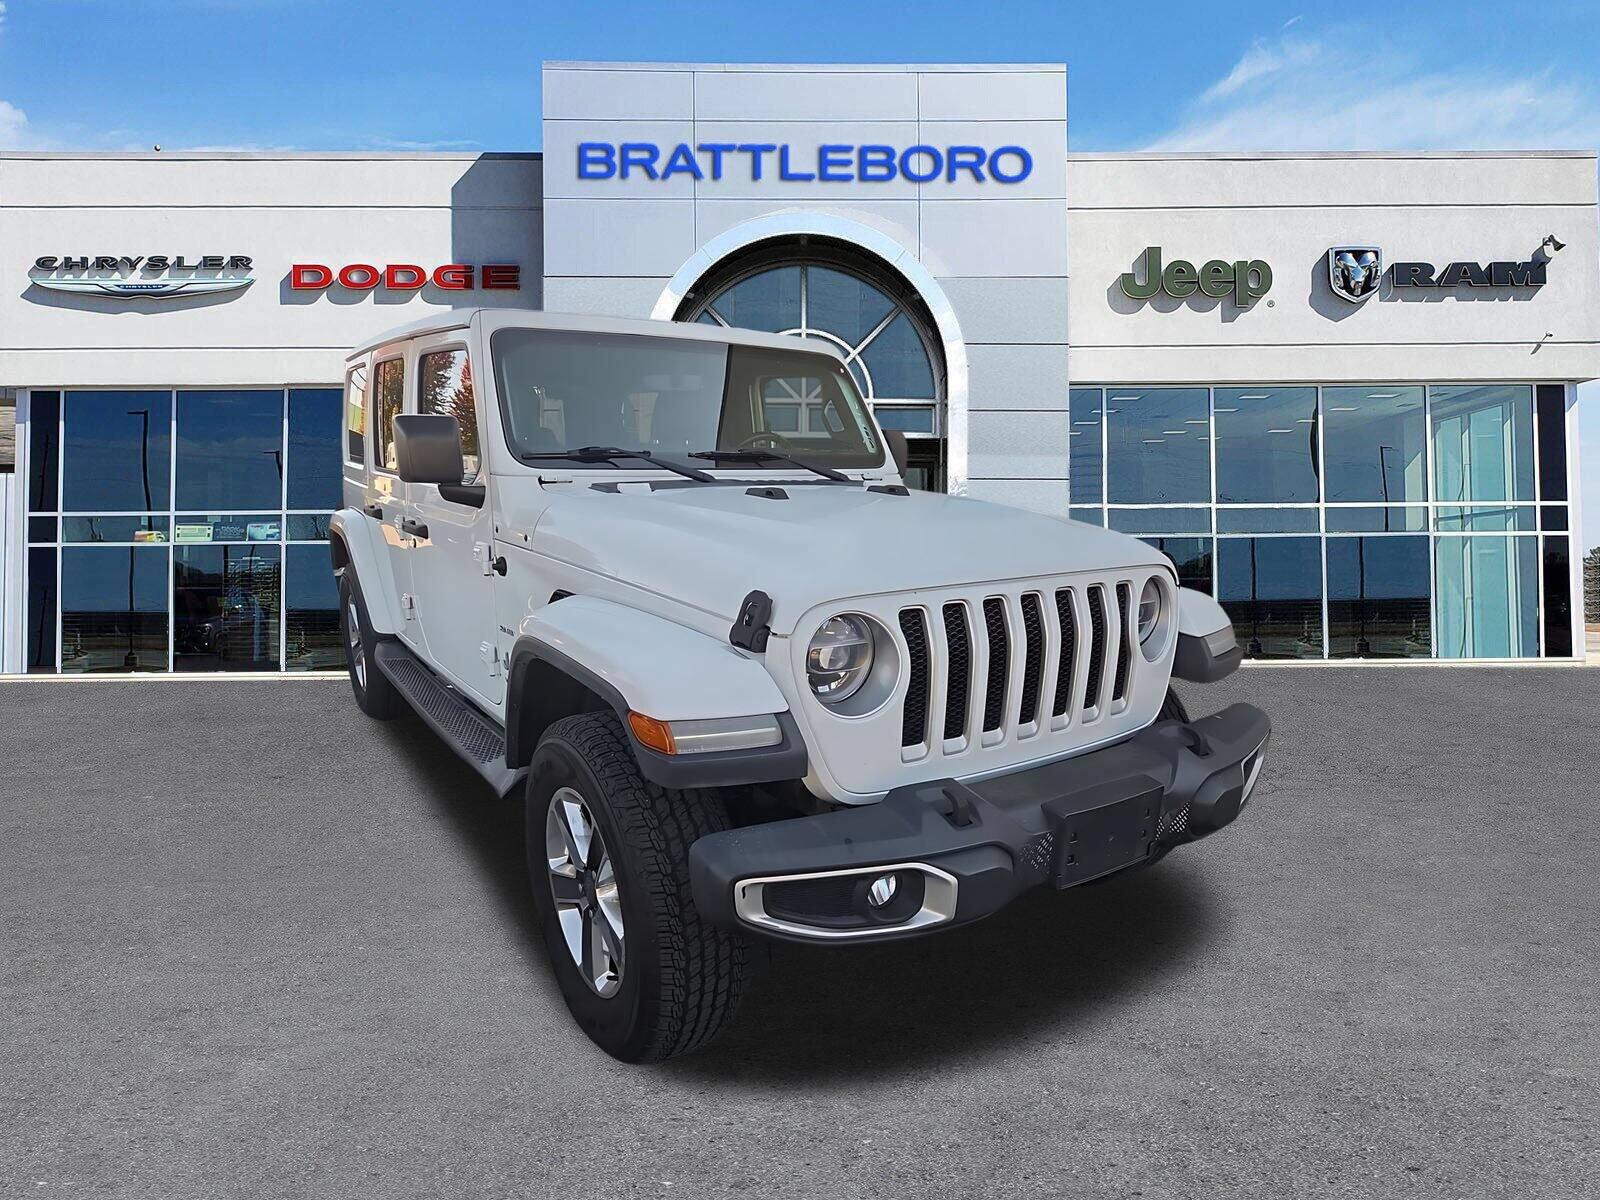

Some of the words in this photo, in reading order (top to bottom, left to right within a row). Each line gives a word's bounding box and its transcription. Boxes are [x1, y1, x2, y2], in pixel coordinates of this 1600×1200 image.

[577, 142, 1034, 184] BRATTLEBORO
[34, 255, 253, 271] CHRYSLER
[1394, 261, 1547, 287] RAM
[291, 264, 521, 290] DODGE
[1120, 246, 1273, 308] Jeep
